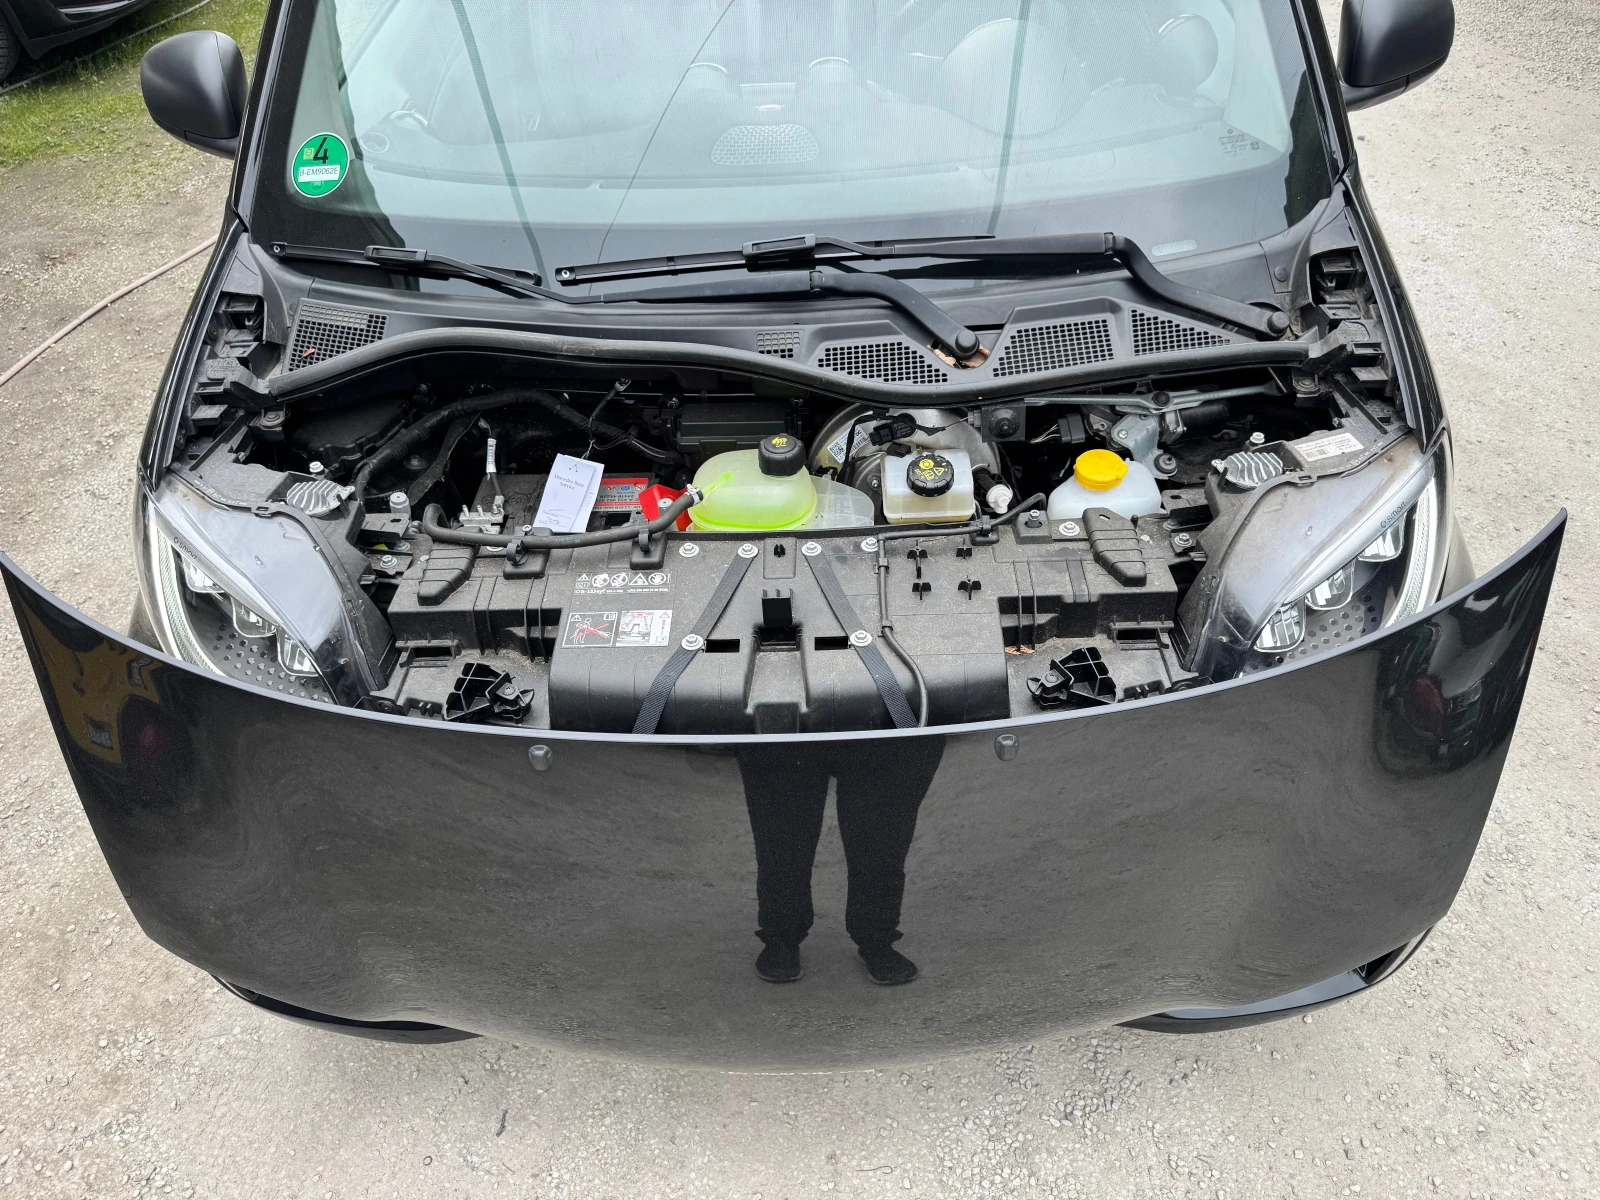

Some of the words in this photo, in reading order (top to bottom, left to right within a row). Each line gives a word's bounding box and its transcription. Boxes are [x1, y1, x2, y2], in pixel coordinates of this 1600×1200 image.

[313, 137, 328, 164] 4
[1387, 501, 1406, 522] smart
[179, 543, 197, 559] smart
